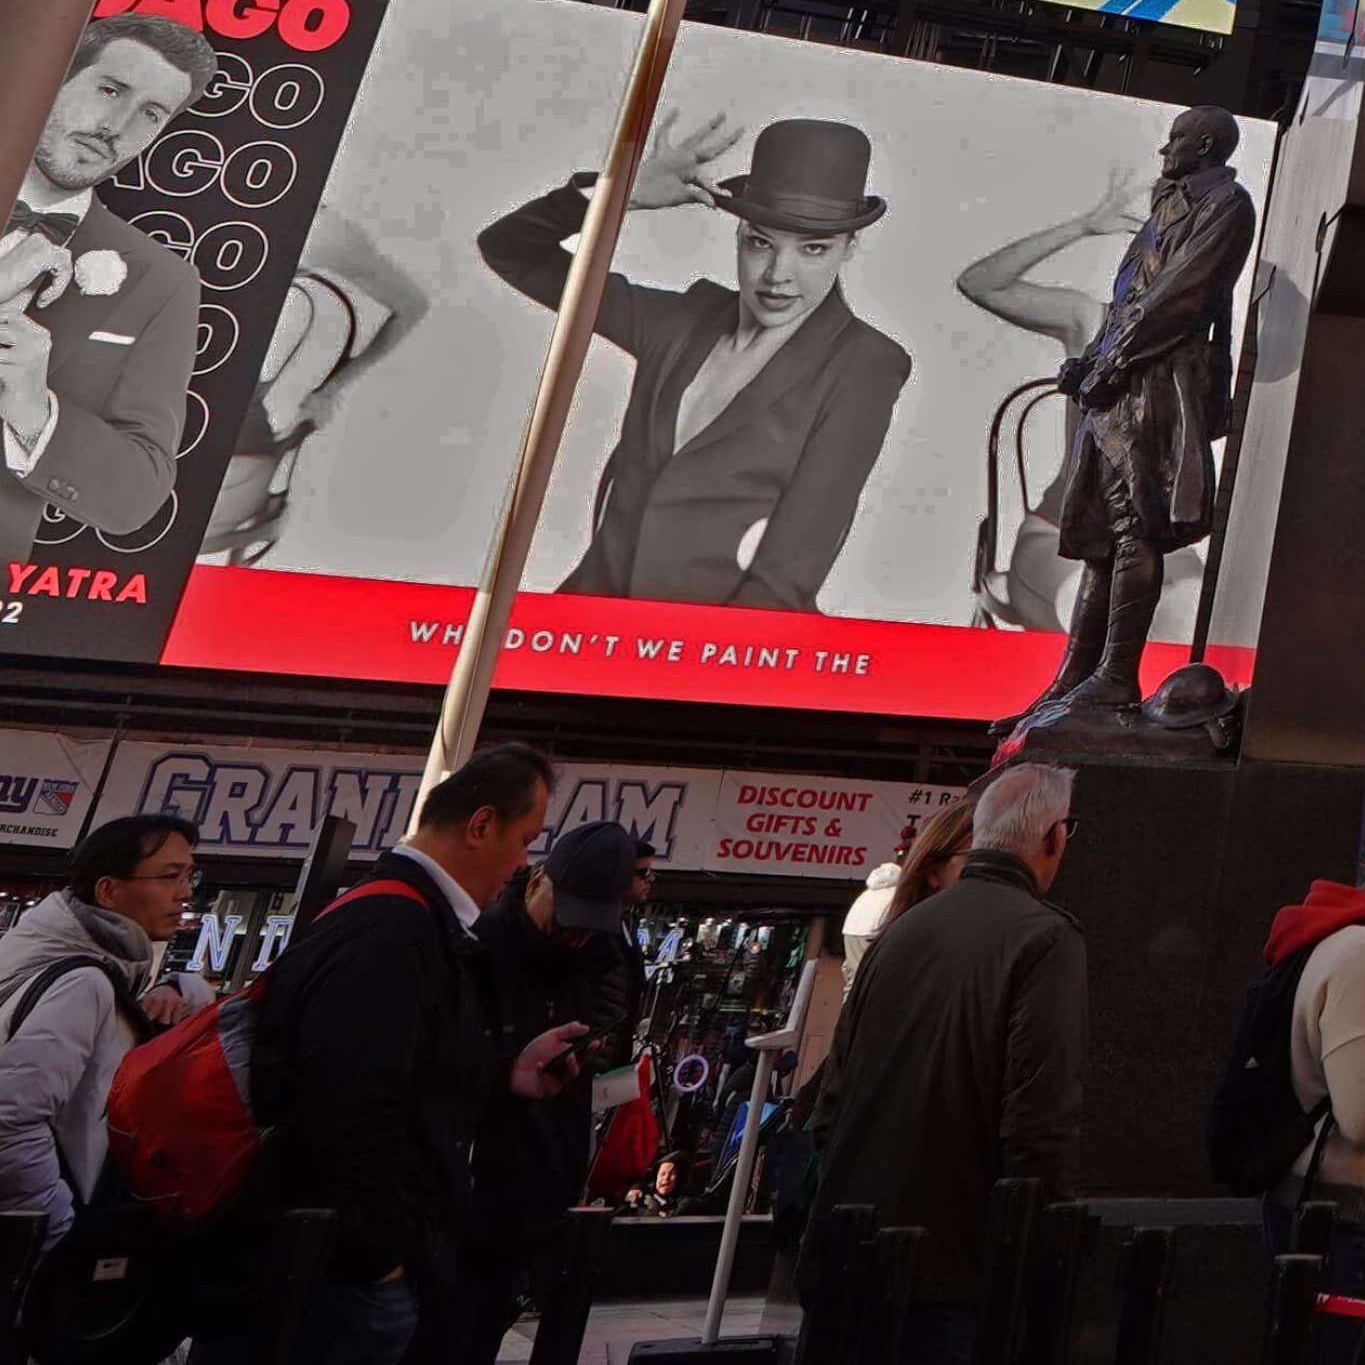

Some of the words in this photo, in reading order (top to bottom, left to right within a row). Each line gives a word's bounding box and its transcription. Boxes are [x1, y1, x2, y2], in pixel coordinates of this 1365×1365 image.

[8, 563, 147, 604] YATRA
[409, 620, 465, 645] WH
[504, 629, 620, 657] DON'T
[637, 638, 684, 662] WE
[700, 643, 800, 670] PAINT
[814, 651, 871, 675] THE
[738, 784, 874, 812] DISCOUNT
[908, 788, 932, 806] #1
[0, 824, 58, 837] RCHANDISE
[746, 813, 818, 837] GIFTS
[824, 818, 843, 838] &
[717, 838, 868, 866] SOUVENIRS
